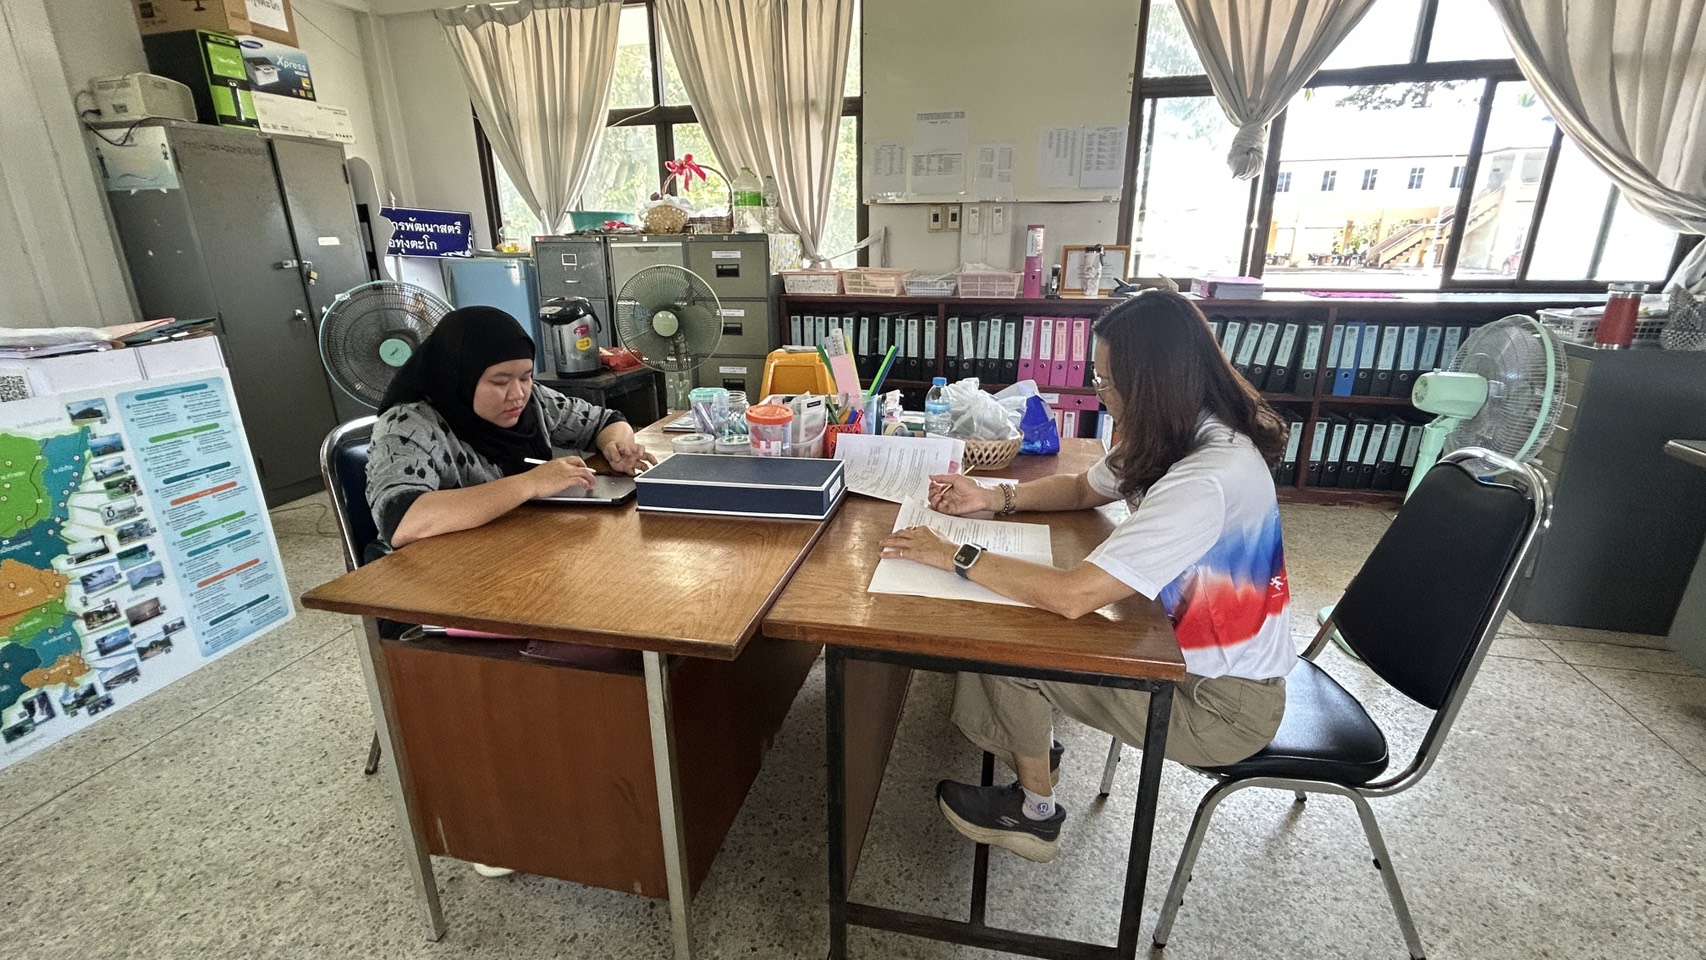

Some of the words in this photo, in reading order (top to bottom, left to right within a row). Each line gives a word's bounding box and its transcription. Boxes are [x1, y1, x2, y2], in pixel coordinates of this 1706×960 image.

[276, 55, 307, 71] Xpress
[391, 217, 461, 235] ารพัฒนาสตรี
[389, 234, 437, 253] อทุ่งตะโก
